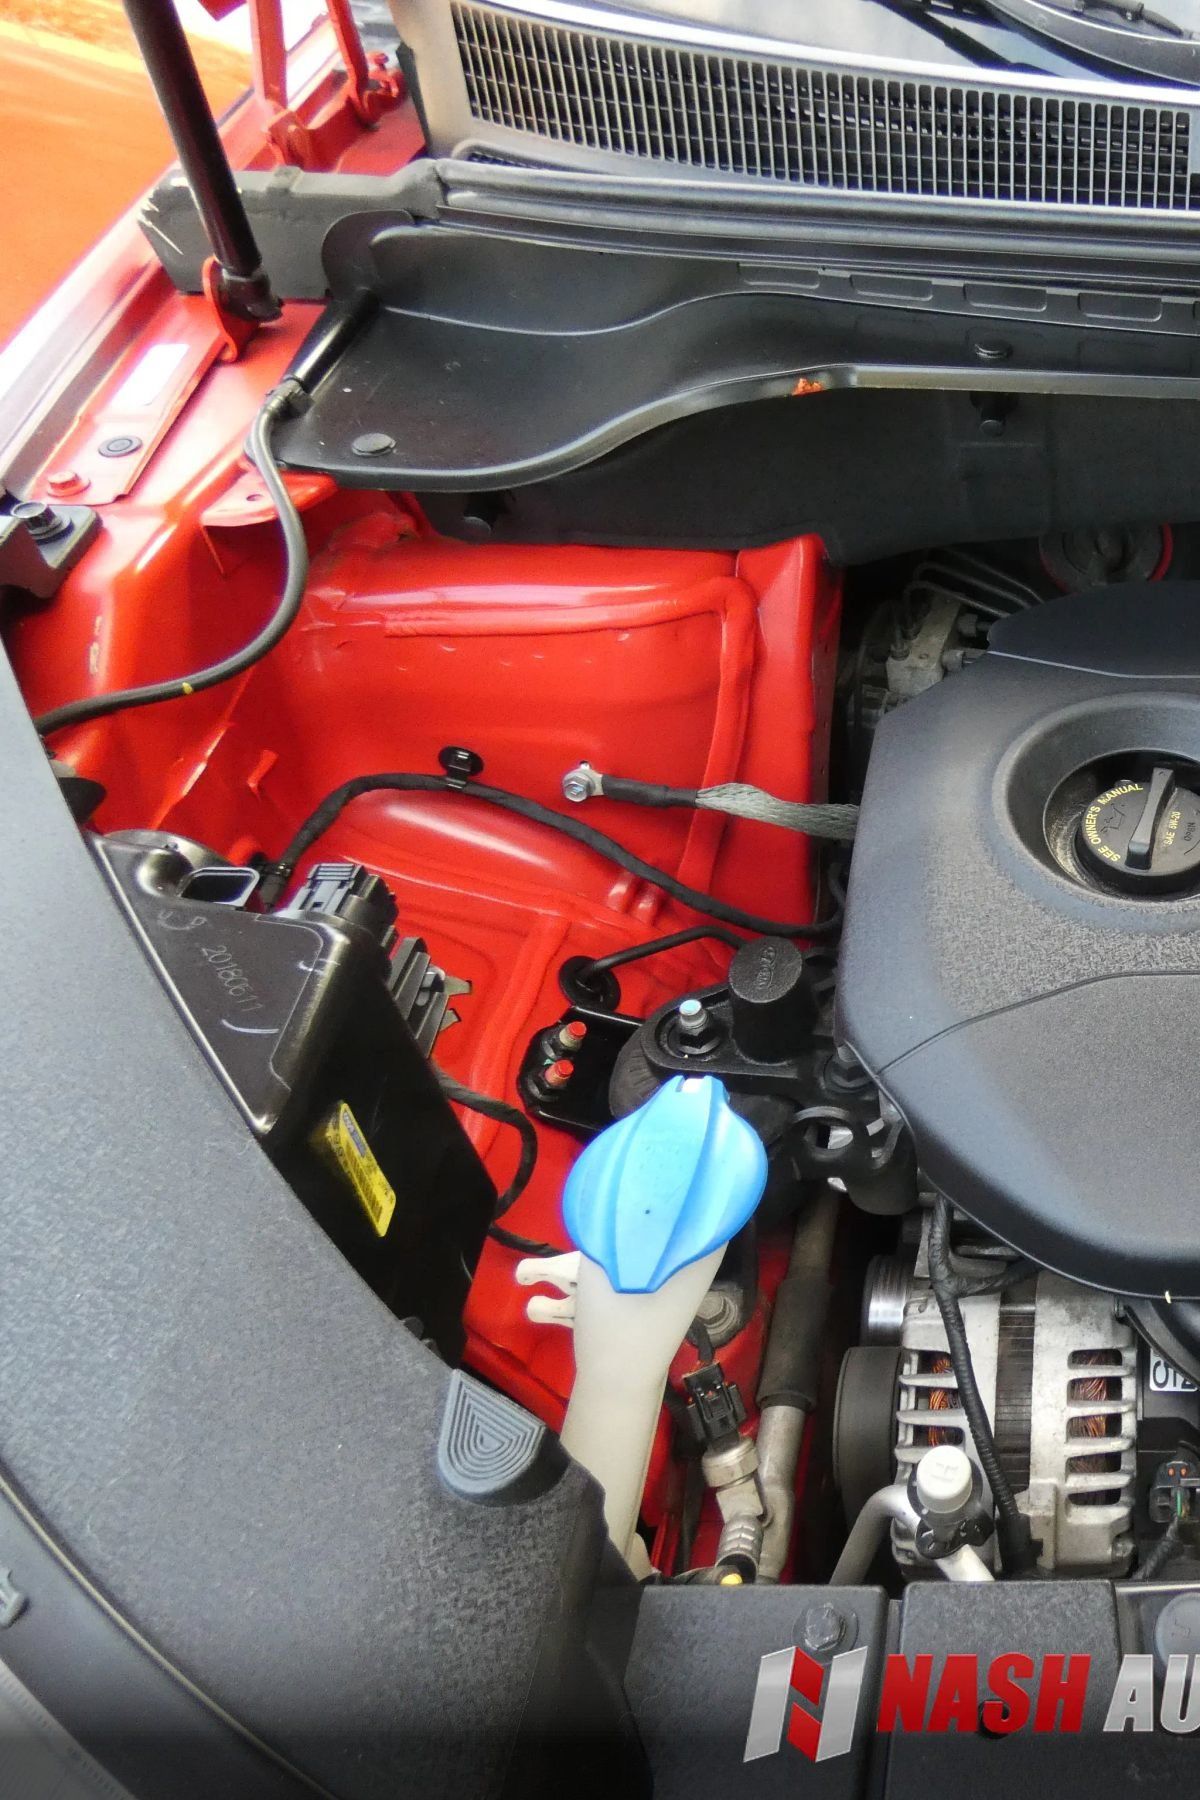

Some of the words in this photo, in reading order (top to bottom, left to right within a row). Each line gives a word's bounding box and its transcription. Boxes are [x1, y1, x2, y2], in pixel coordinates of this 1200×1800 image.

[1097, 783, 1144, 805] MANUAL
[1085, 806, 1102, 845] OWNER'S
[1163, 831, 1176, 846] SAE
[1097, 845, 1121, 862] SEE
